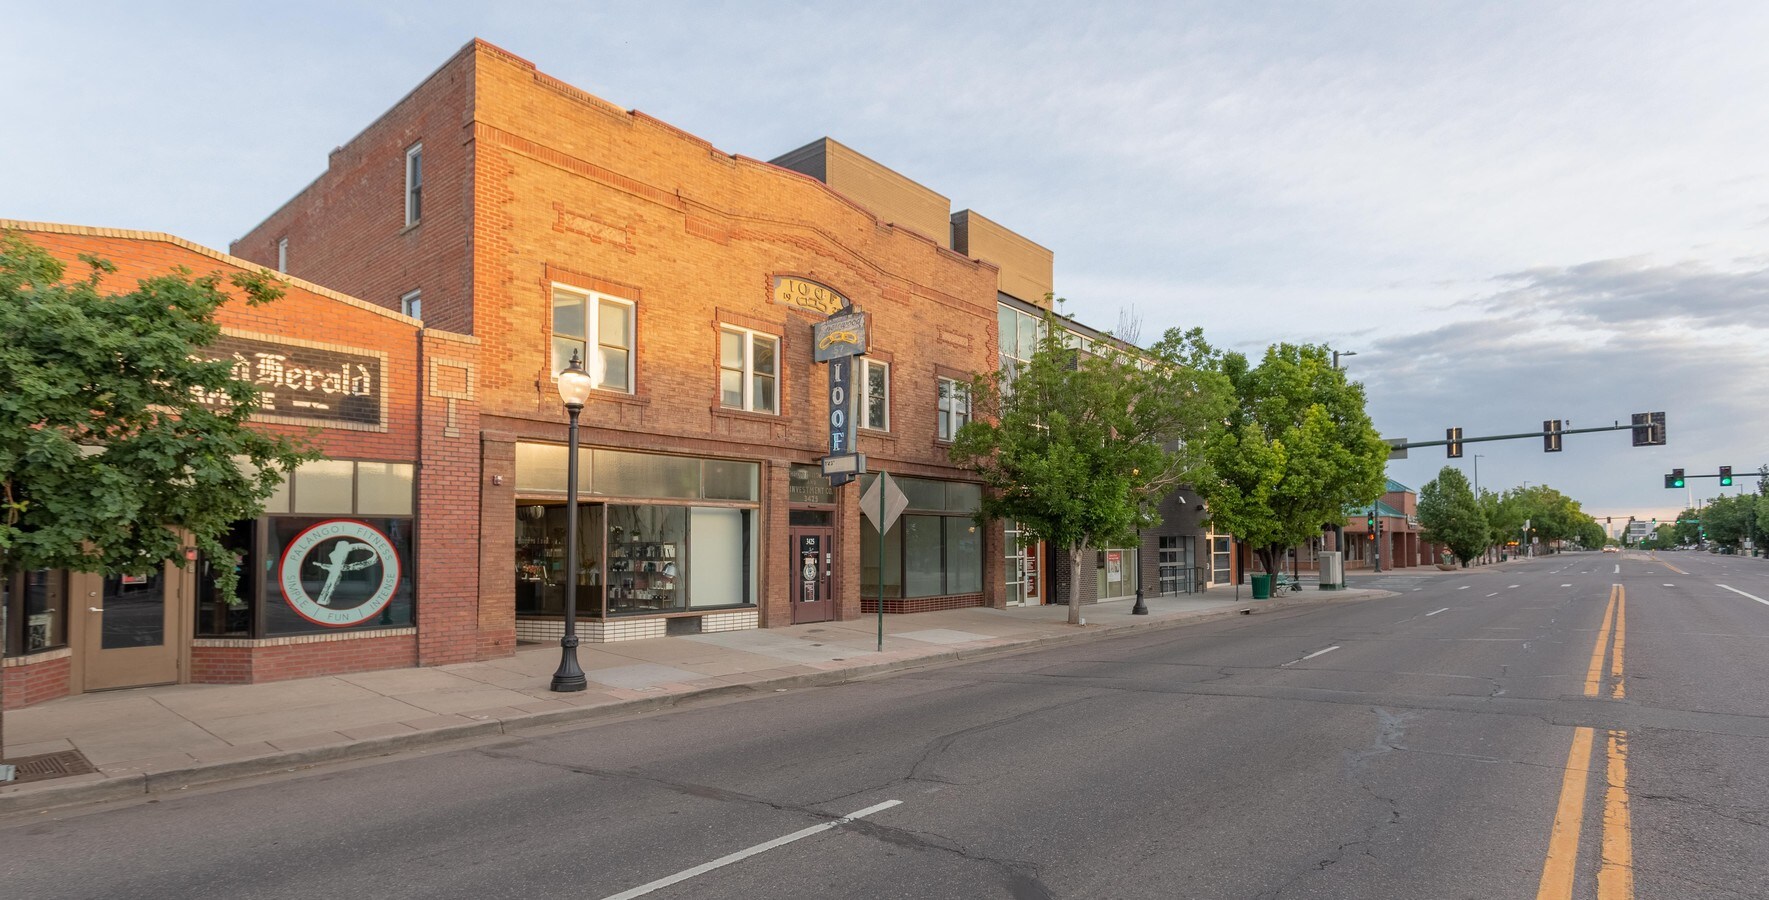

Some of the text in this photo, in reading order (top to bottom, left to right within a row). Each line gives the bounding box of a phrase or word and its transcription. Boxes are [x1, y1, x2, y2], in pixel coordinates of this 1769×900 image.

[255, 352, 371, 396] Herald
[831, 363, 845, 451] IOOF
[290, 525, 393, 561] PALANGOI FITNESS
[287, 573, 395, 621] SIMPLE FUN INTENSE
